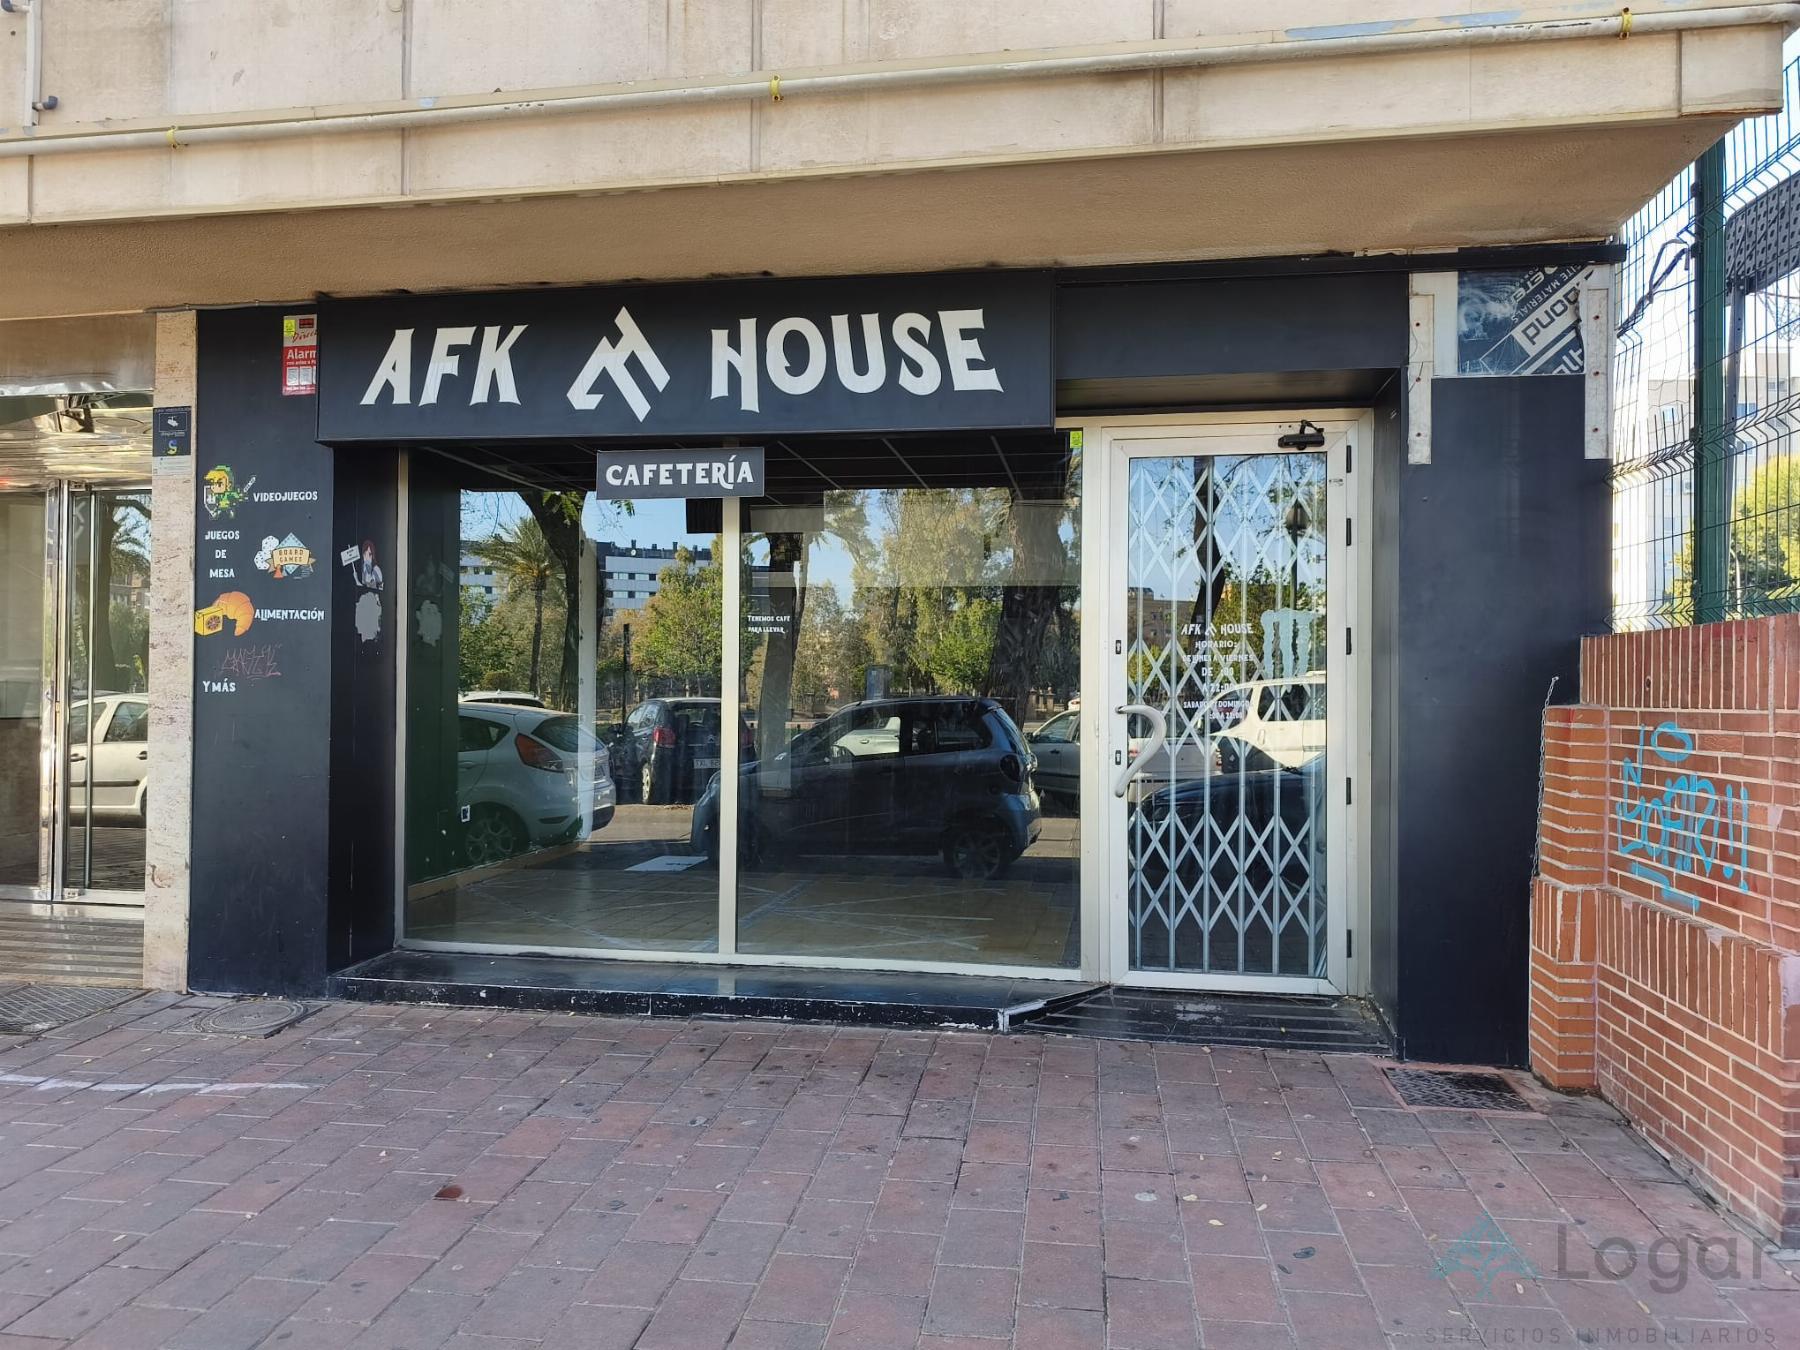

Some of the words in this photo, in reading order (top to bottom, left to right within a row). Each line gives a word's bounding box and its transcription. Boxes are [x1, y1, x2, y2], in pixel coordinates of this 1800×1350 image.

[1511, 279, 1561, 324] MATERIALS
[358, 323, 530, 407] AFK
[710, 307, 1004, 414] HOUSE
[605, 455, 755, 490] CAFETERÍA
[252, 490, 319, 503] VIDEOJUEGOS
[204, 530, 241, 541] JUEGOS
[214, 549, 227, 559] DE
[208, 567, 236, 579] MESA
[254, 606, 325, 621] ALIMENTACIÓN
[1180, 623, 1202, 636] AFK
[1220, 623, 1254, 636] HOUSE
[1201, 666, 1214, 677] DE
[202, 680, 211, 693] Y
[211, 678, 236, 693] MÁS
